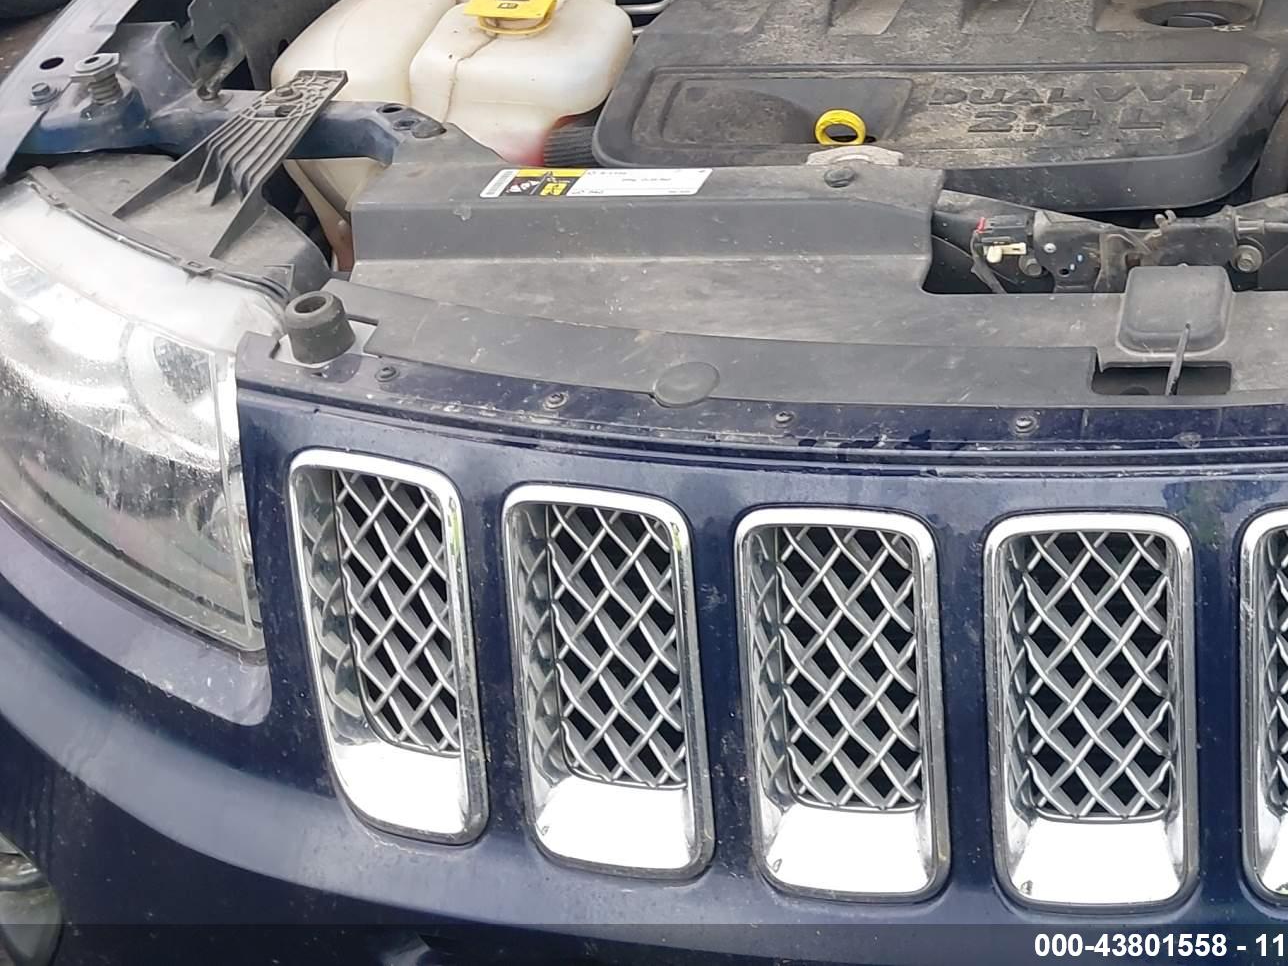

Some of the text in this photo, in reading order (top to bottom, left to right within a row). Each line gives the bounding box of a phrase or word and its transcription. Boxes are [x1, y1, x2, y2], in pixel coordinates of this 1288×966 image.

[928, 84, 1216, 106] DUAL VVT
[967, 108, 1165, 133] 2.4 L
